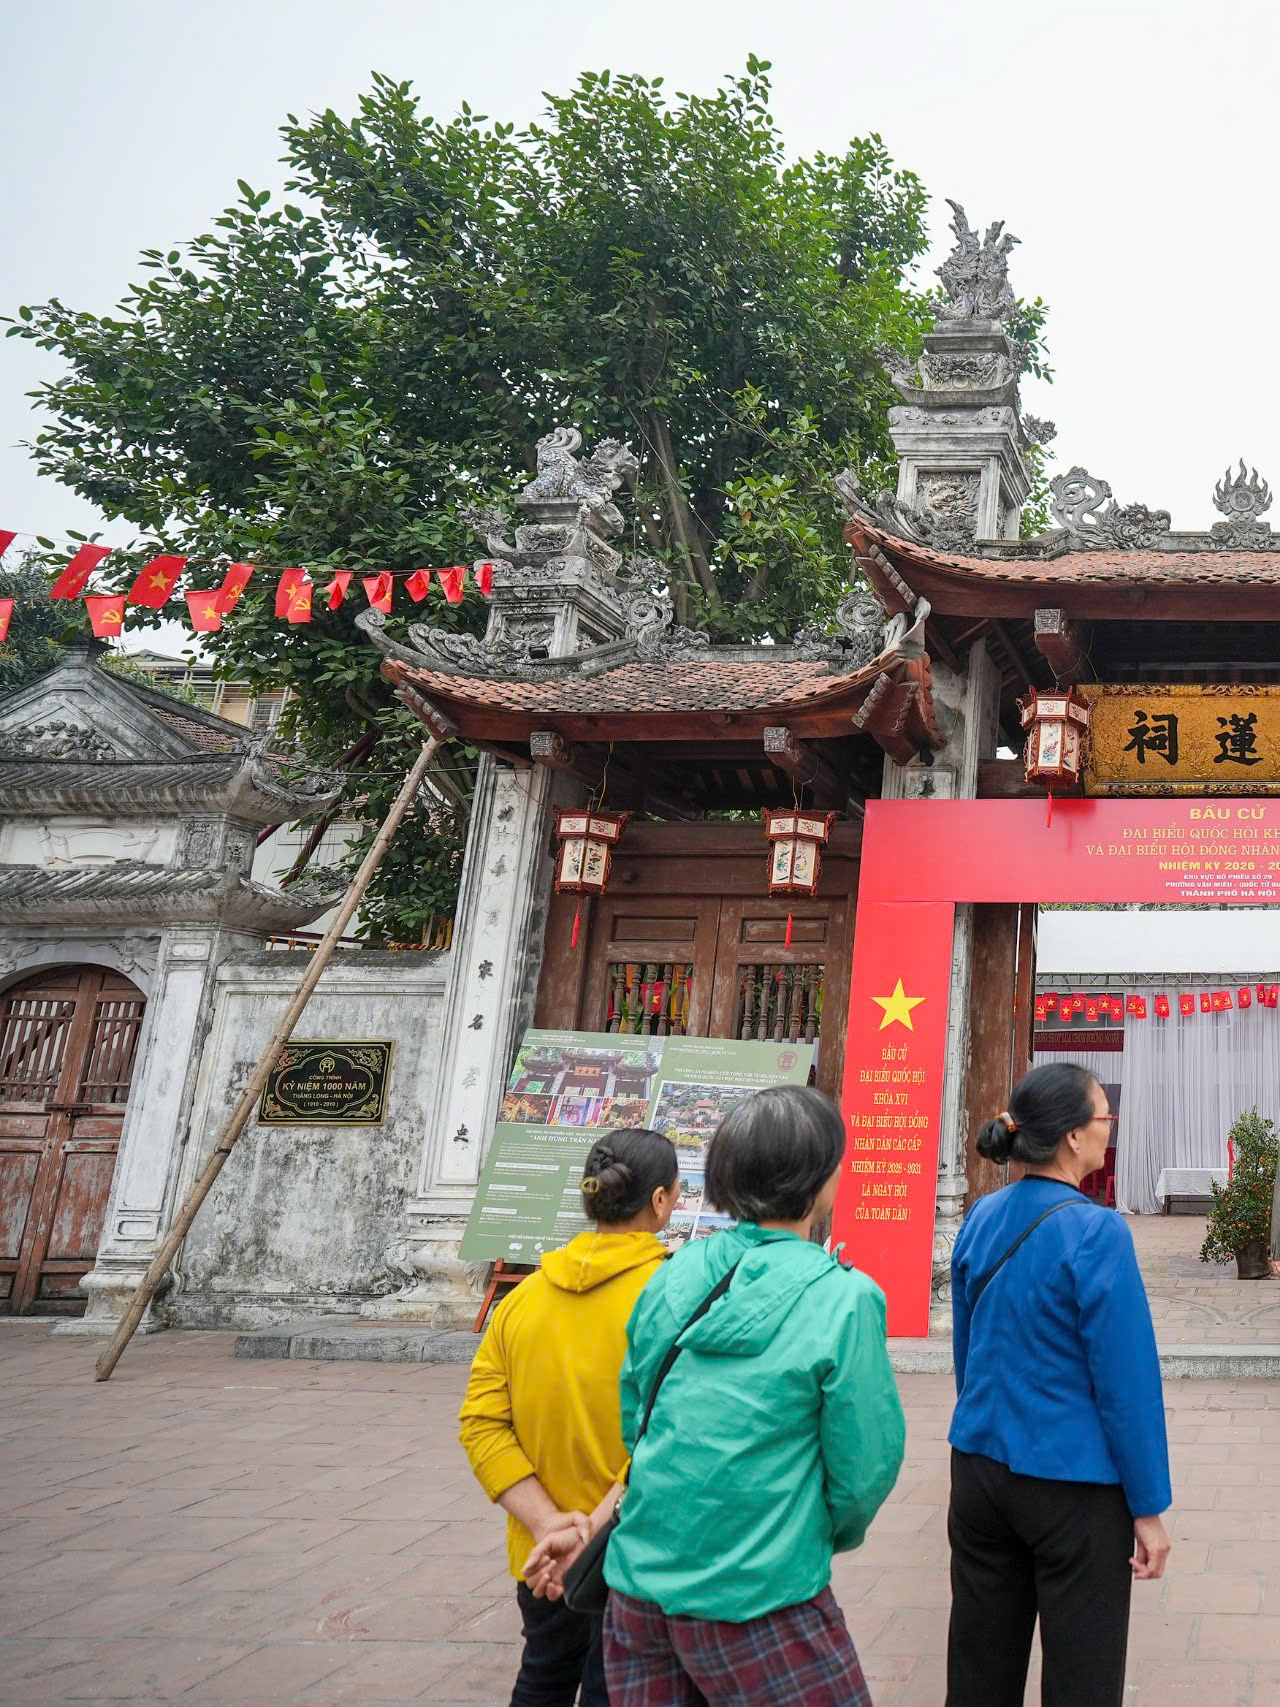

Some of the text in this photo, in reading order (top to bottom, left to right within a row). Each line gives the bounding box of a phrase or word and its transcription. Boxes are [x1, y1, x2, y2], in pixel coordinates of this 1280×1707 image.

[1190, 804, 1266, 820] BẦU CỬ
[1123, 828, 1147, 840] ĐẠI
[1152, 822, 1185, 839] BIỂU
[1190, 825, 1227, 840] QUỐC
[1233, 826, 1258, 840] HỘI
[1087, 842, 1104, 855] VÀ
[1108, 844, 1131, 857] ĐẠI
[1136, 840, 1167, 855] BIỂU
[1172, 843, 1195, 857] HỘI
[1200, 840, 1237, 856] ĐỒNG
[1241, 842, 1279, 855] NHÂN
[1159, 860, 1200, 871] NHIỆM
[1225, 861, 1255, 870] 2026
[1258, 889, 1276, 897] NỘI
[882, 1042, 907, 1060] BẦU CỬ
[860, 1063, 925, 1086] ĐẠI BIỂU QUỐC HỘI
[282, 1080, 366, 1092] KỶ NIỆM 1000 NĂM
[343, 1092, 354, 1100] NỘI
[895, 1094, 908, 1104] XVI
[851, 1108, 928, 1131] VÀ ĐẠI BIỂU HỘI ĐỒNG
[855, 1134, 921, 1150] NHÂN DÂN CÁC CẤP
[851, 1158, 874, 1176] NHIỆM
[888, 1163, 902, 1173] 2026
[908, 1163, 921, 1174] 2031
[862, 1181, 907, 1200] LÀ NGÀY HỘI
[856, 1202, 870, 1220] CỦA
[871, 1204, 890, 1220] TOÀN
[892, 1204, 907, 1220] DÂN
